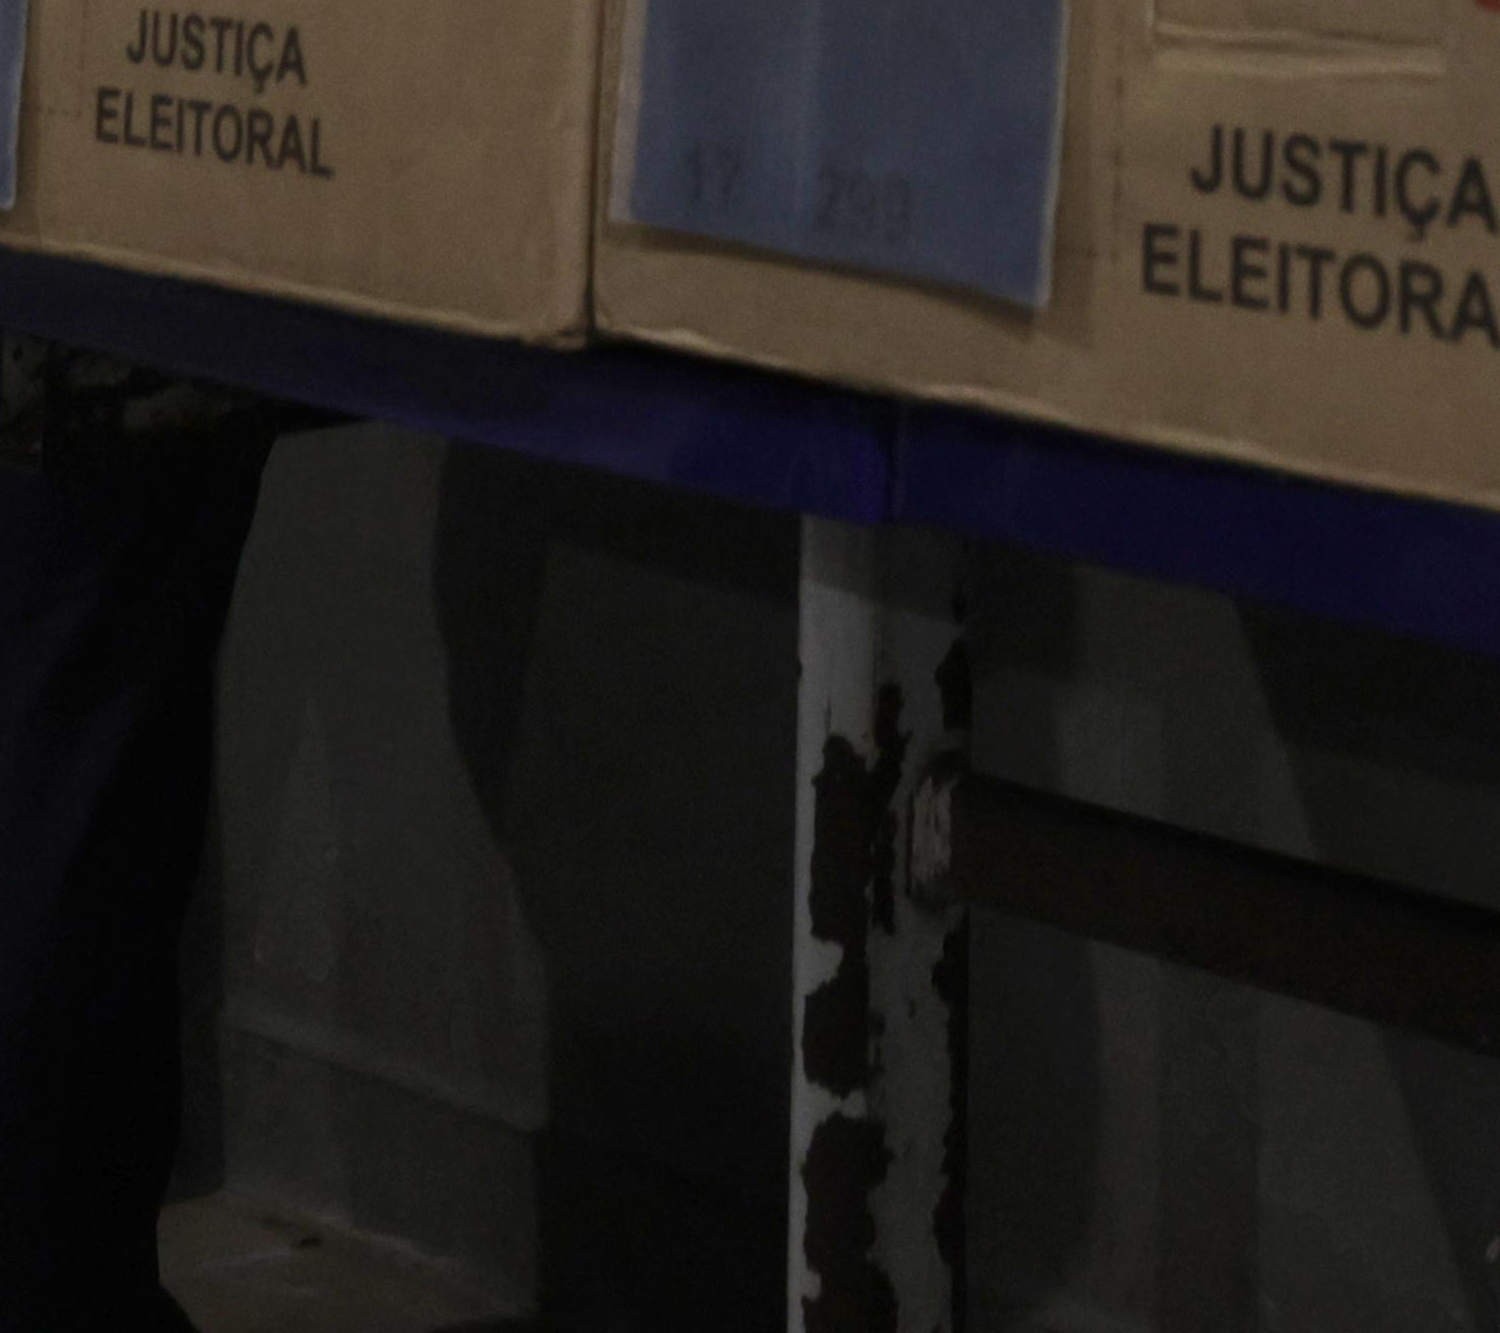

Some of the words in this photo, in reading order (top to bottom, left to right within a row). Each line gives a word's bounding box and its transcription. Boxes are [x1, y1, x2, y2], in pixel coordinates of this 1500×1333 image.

[124, 12, 306, 103] JUSTIÇA
[94, 81, 331, 178] ELEITORAL
[1188, 128, 1498, 251] JUSTIÇA
